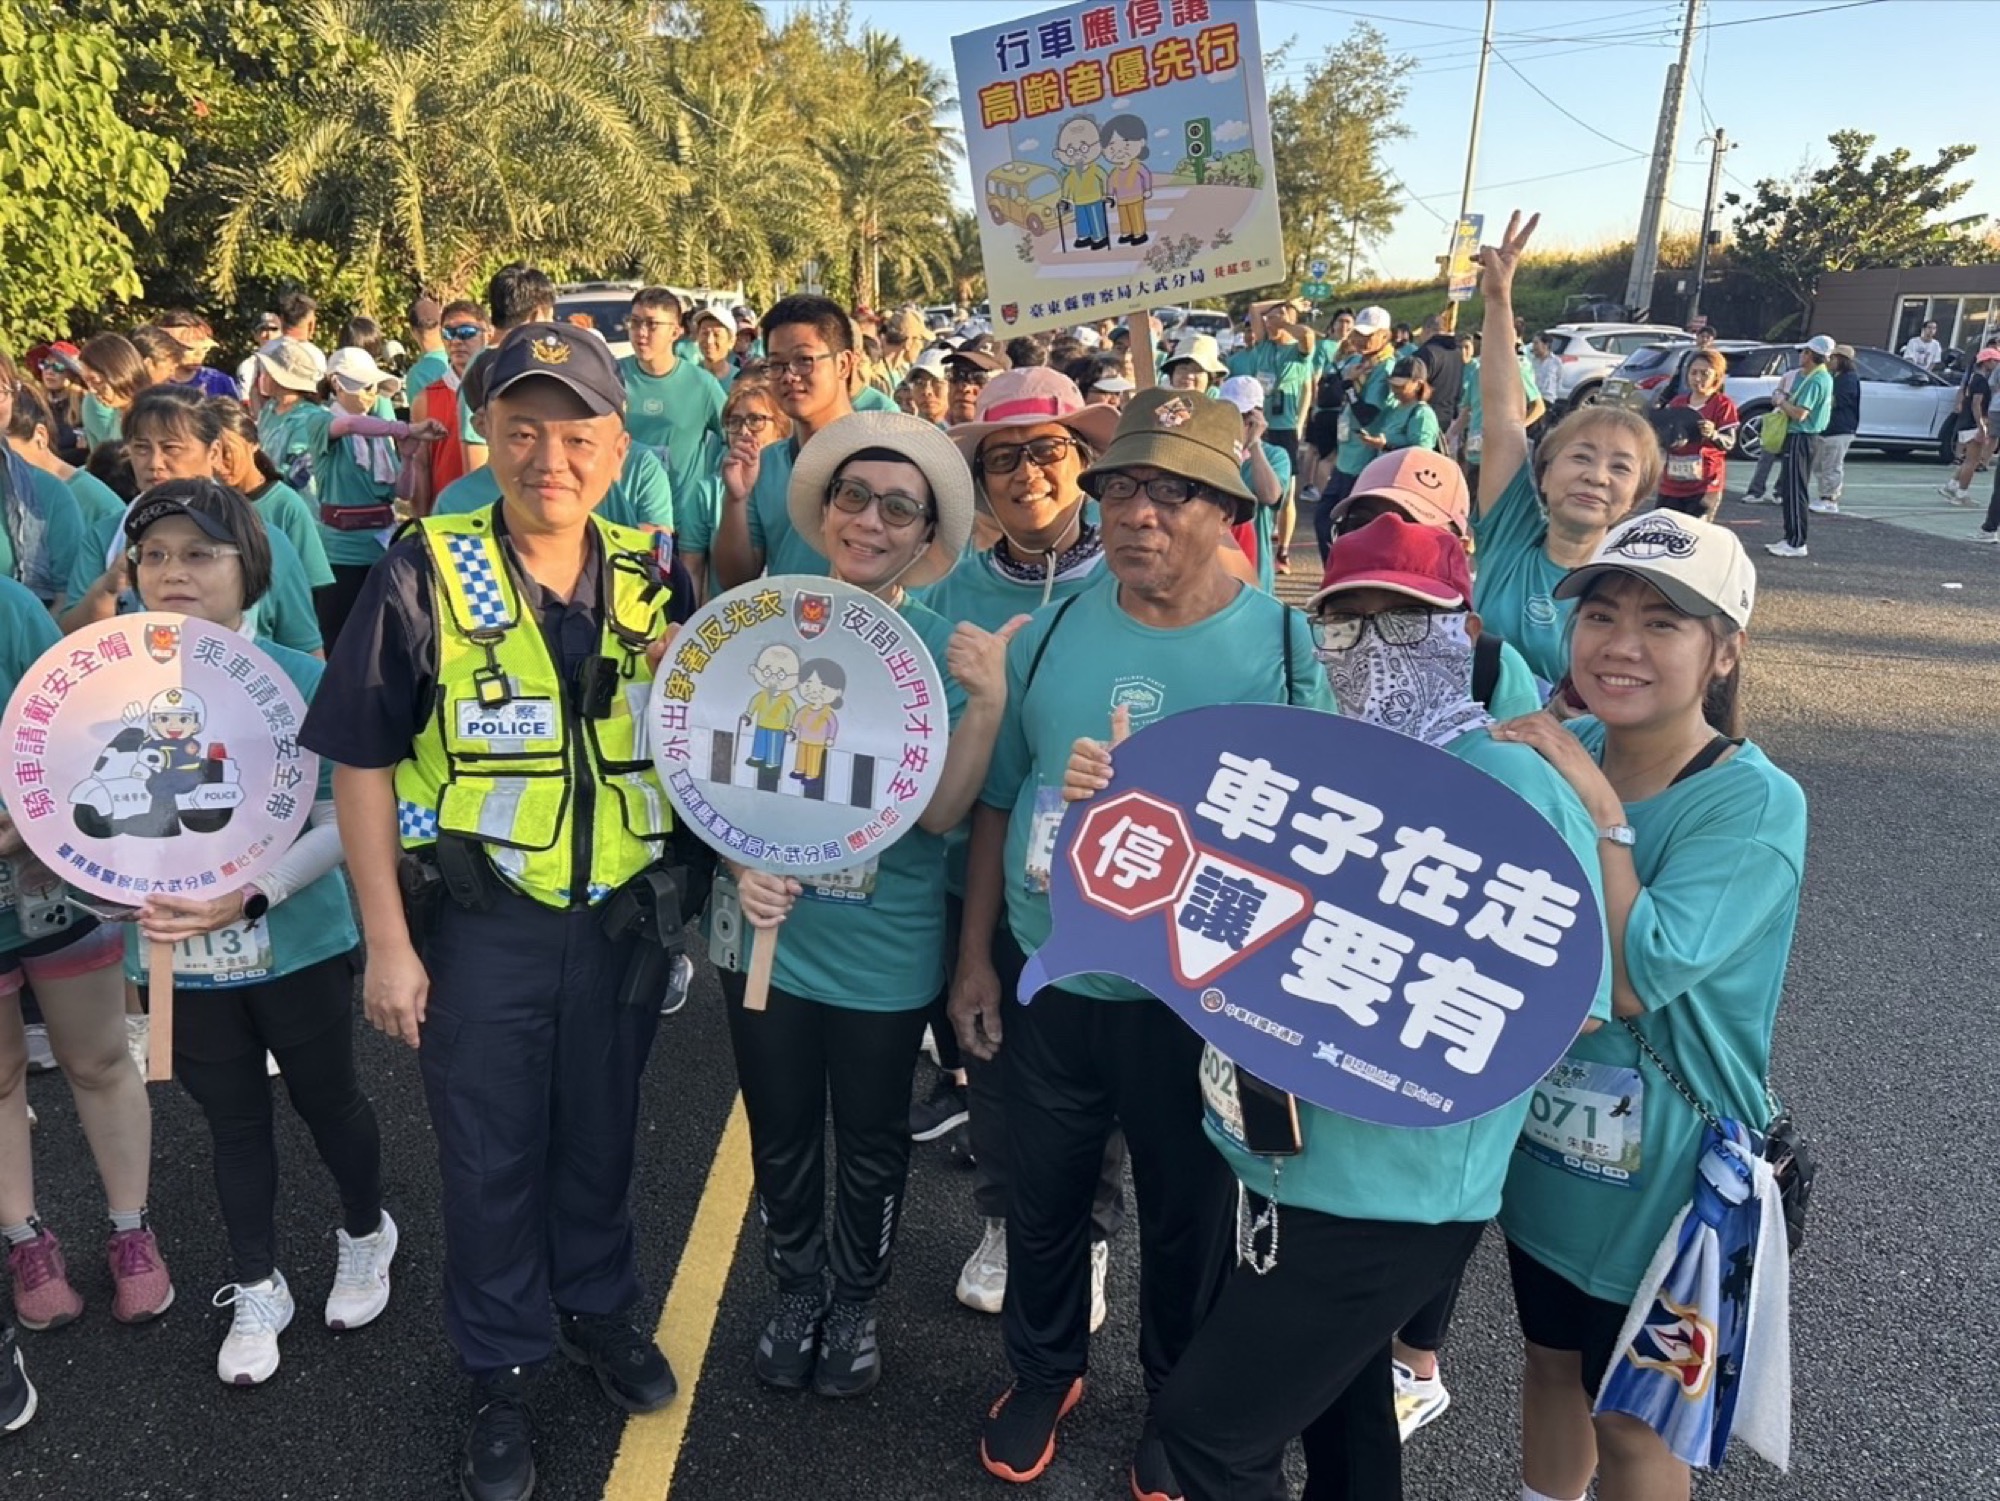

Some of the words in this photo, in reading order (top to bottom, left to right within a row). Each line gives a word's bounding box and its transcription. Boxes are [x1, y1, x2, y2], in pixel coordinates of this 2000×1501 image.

[978, 22, 1241, 129] 高齡者優先行
[996, 0, 1211, 73] 行車應停讓
[1029, 268, 1205, 319] 臺東縣警察局大武分局
[660, 588, 786, 763] 外出穿著反光衣
[841, 601, 934, 803] 夜間出門才安全
[14, 631, 133, 820] 騎車請戴安全帽
[193, 635, 304, 822] 乘車請繫安全帶
[467, 721, 546, 735] POLICE
[204, 791, 237, 800] POLICE
[1093, 815, 1174, 889] 停
[1195, 750, 1582, 968] 車子在走
[172, 929, 242, 957] 113
[1178, 866, 1268, 953] 讓
[1280, 900, 1526, 1075] 要有
